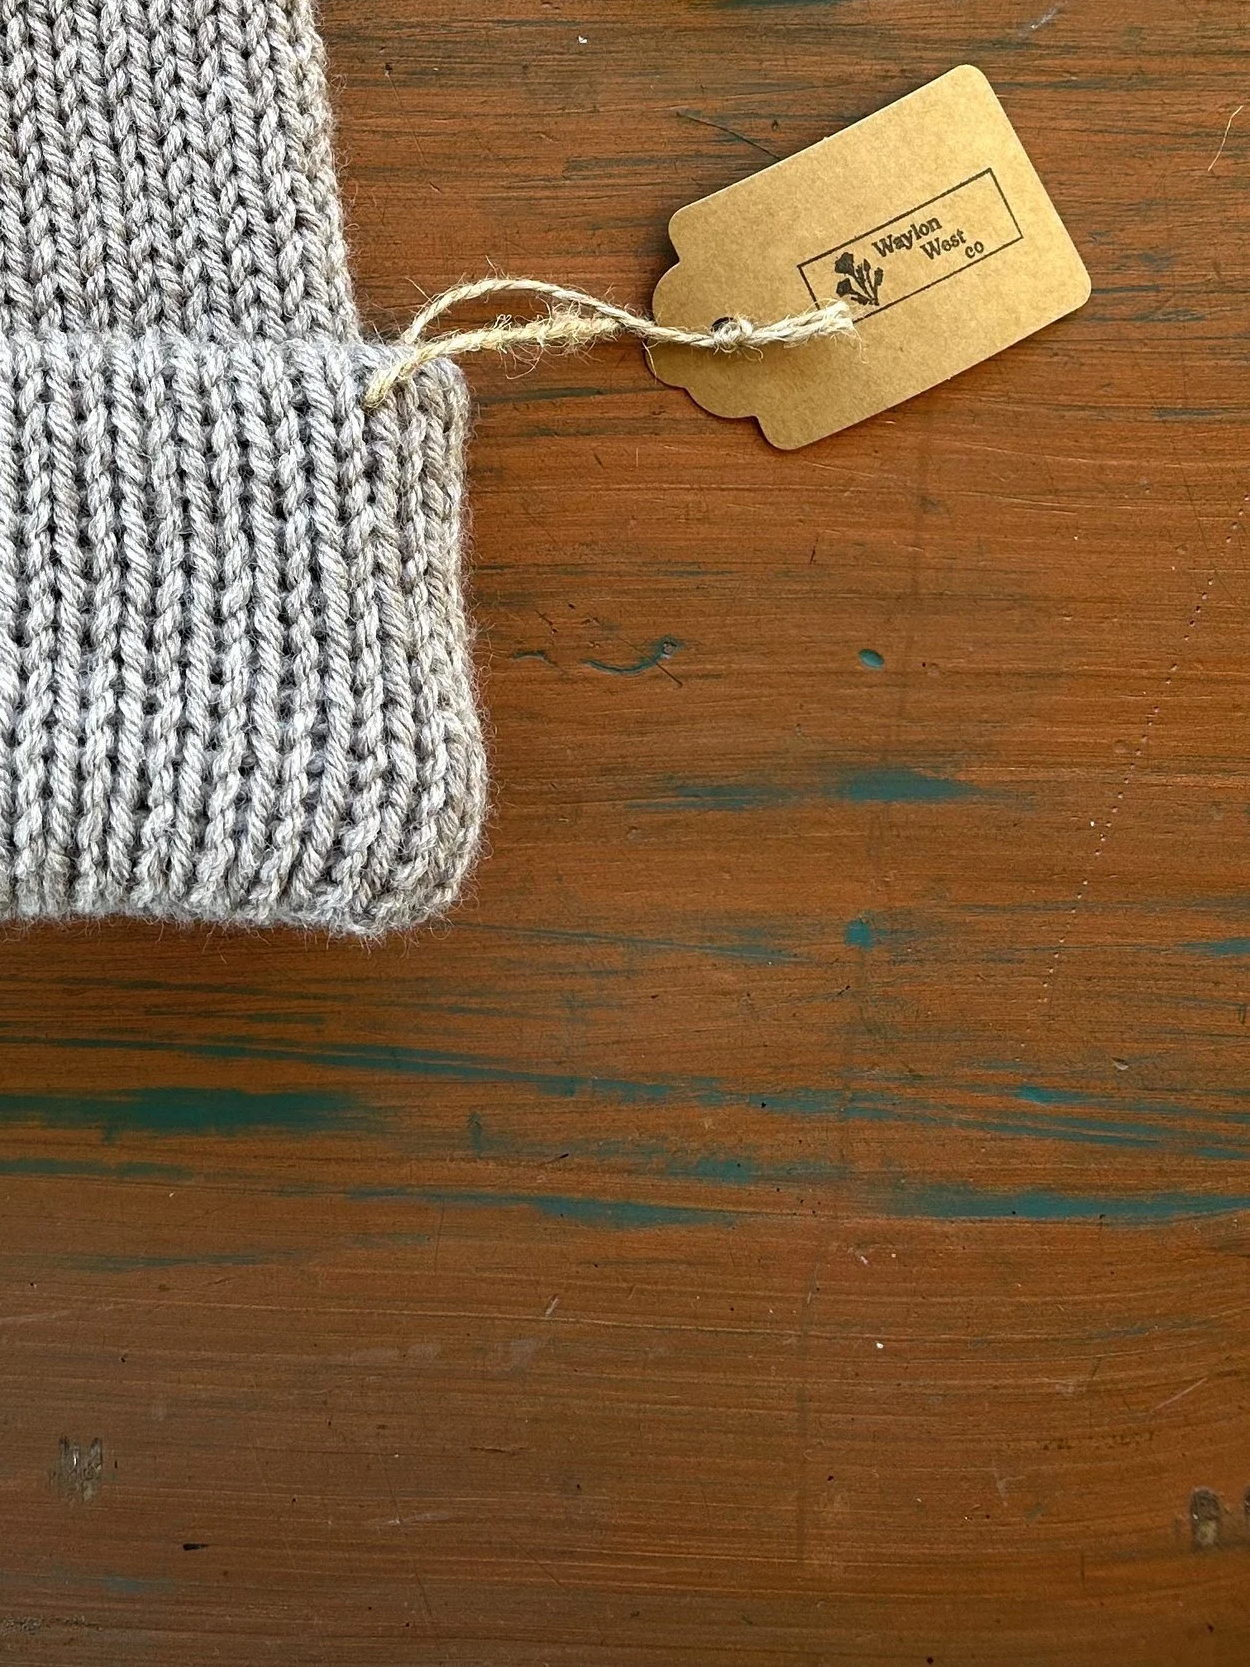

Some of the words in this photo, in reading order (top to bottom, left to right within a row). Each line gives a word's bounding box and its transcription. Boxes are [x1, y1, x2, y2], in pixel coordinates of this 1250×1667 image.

[871, 217, 942, 258] Waylon
[920, 228, 967, 260] West
[965, 241, 984, 259] co
